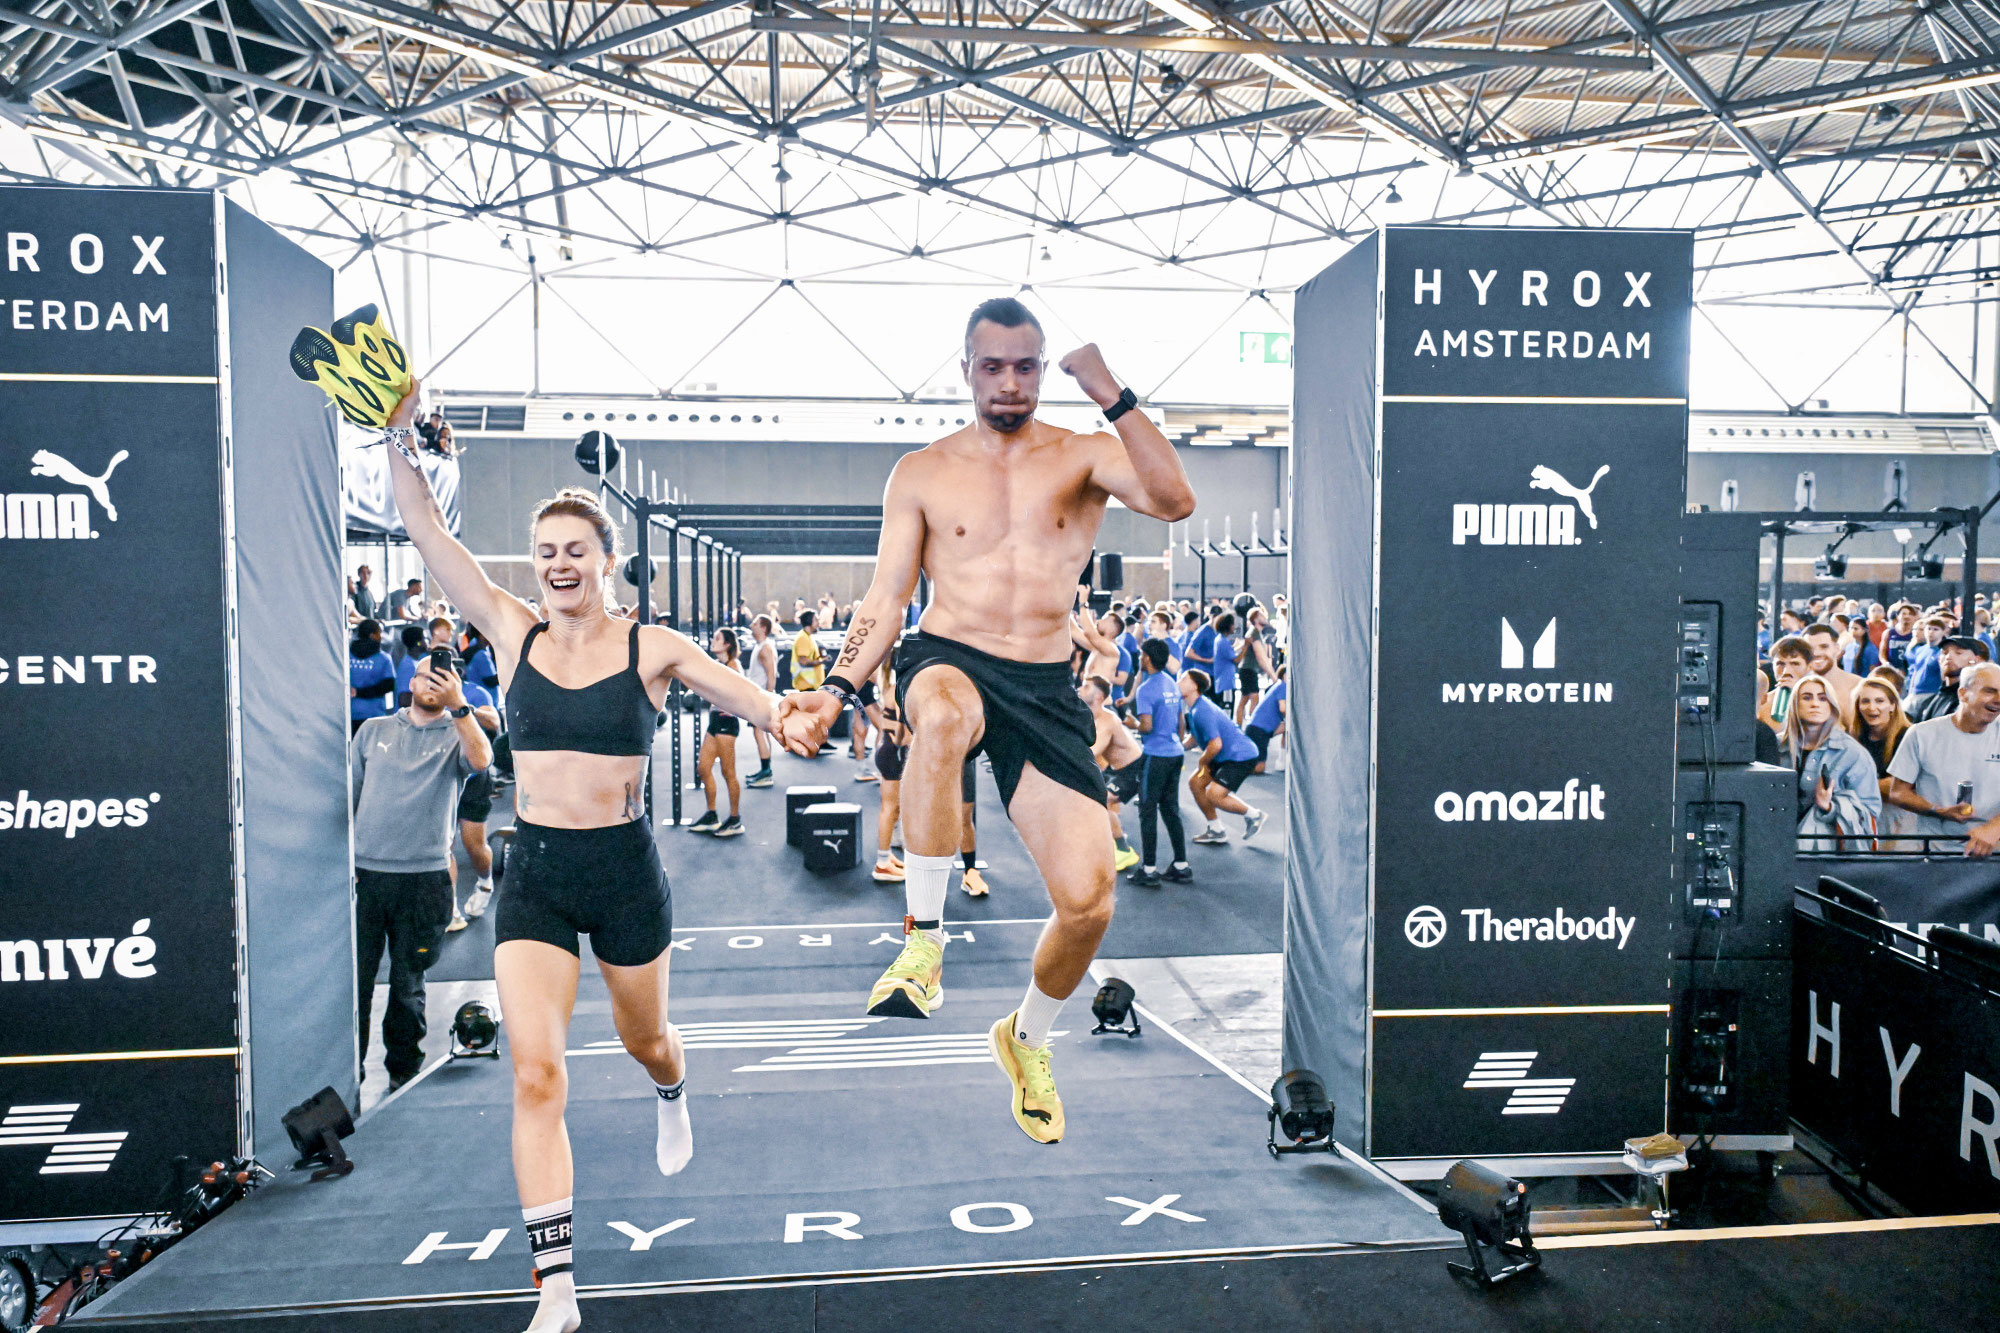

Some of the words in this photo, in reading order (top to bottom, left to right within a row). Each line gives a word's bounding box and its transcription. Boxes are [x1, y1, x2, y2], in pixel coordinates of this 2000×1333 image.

[1414, 268, 1652, 308] HYROX
[1413, 329, 1651, 360] AMSTERDAM
[1442, 682, 1613, 703] MYPROTEIN
[1434, 777, 1606, 822] amazfit
[1460, 906, 1636, 950] Therabody
[401, 1193, 1207, 1265] HYROX
